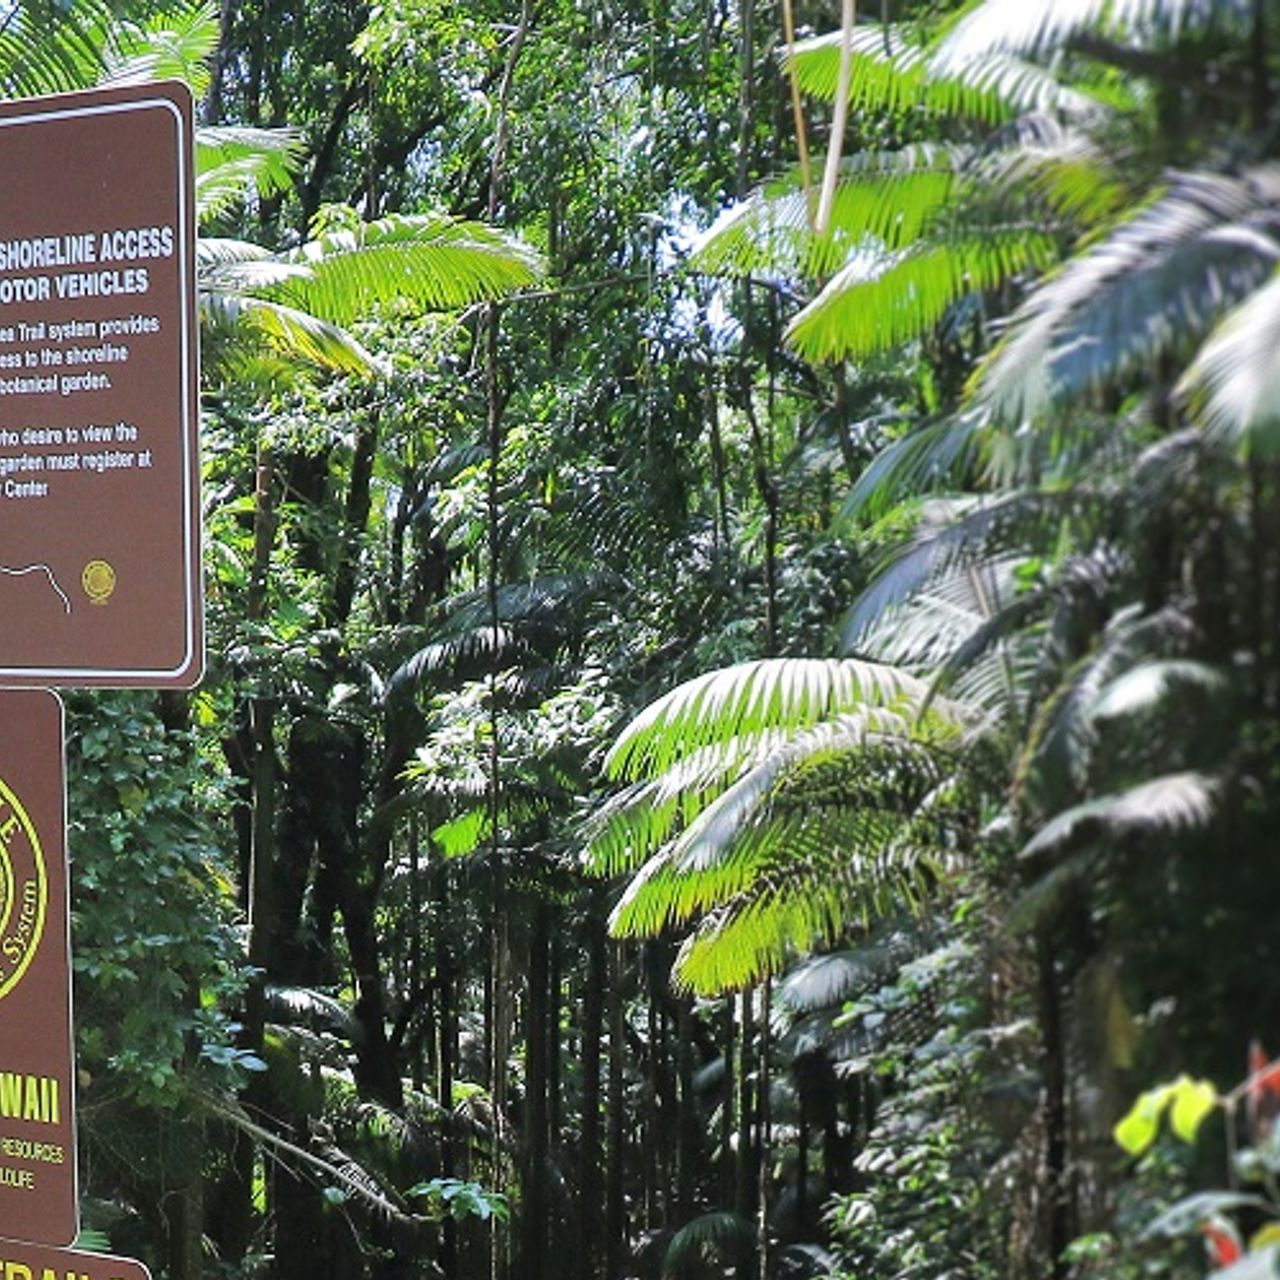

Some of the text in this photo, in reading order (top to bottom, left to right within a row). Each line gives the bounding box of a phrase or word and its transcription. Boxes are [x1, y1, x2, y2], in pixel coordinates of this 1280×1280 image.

[100, 226, 173, 261] ACCESS
[55, 268, 149, 298] VEHICLES
[19, 321, 45, 340] Trail
[49, 319, 96, 342] system
[100, 315, 160, 338] provides
[25, 351, 37, 367] to
[41, 348, 63, 366] the
[66, 344, 129, 363] shoreline
[61, 372, 111, 396] garden.
[22, 428, 62, 445] desire
[66, 428, 78, 443] to
[82, 424, 113, 442] view
[116, 422, 137, 441] the
[47, 454, 80, 471] must
[82, 451, 133, 473] register
[137, 450, 152, 467] at
[5, 480, 48, 498] Center
[3, 880, 36, 964] System
[2, 1137, 64, 1164] RESOURCES
